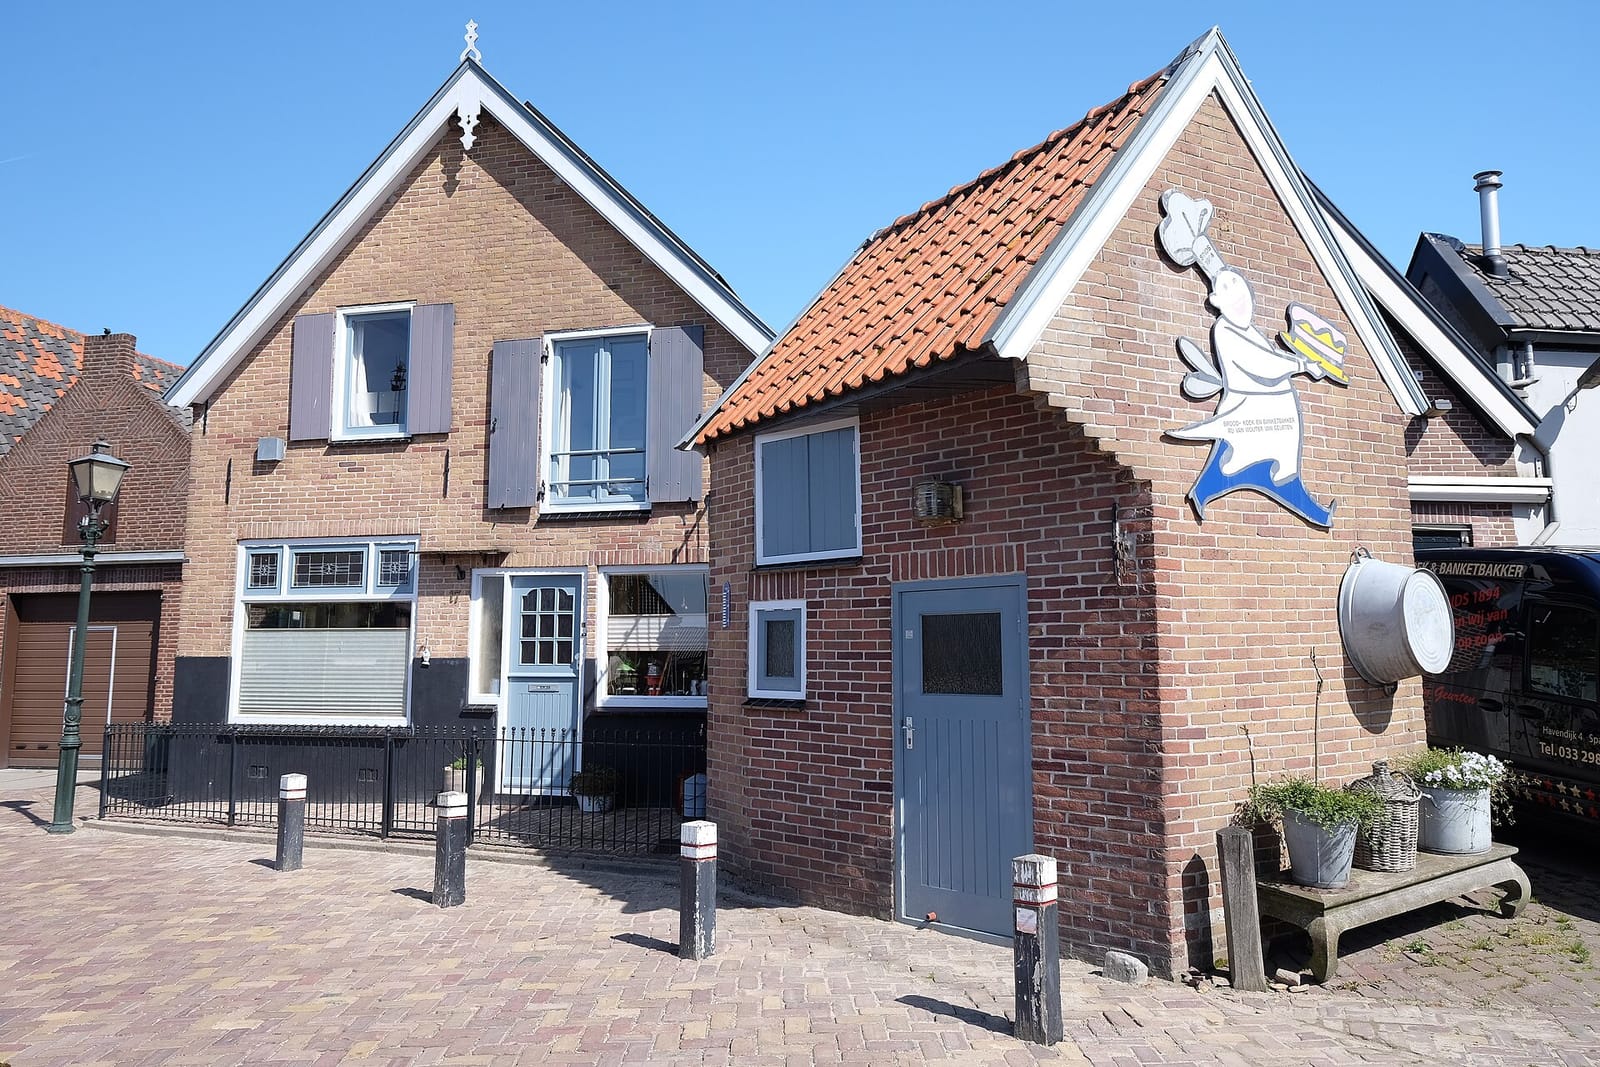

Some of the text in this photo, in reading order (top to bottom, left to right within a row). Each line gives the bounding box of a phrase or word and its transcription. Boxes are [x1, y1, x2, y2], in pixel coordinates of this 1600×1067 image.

[1439, 562, 1524, 577] BANKETBAKKER
[1472, 586, 1500, 603] 1894
[1487, 608, 1508, 622] van
[1542, 726, 1577, 741] Havendijk
[1578, 732, 1583, 741] 4
